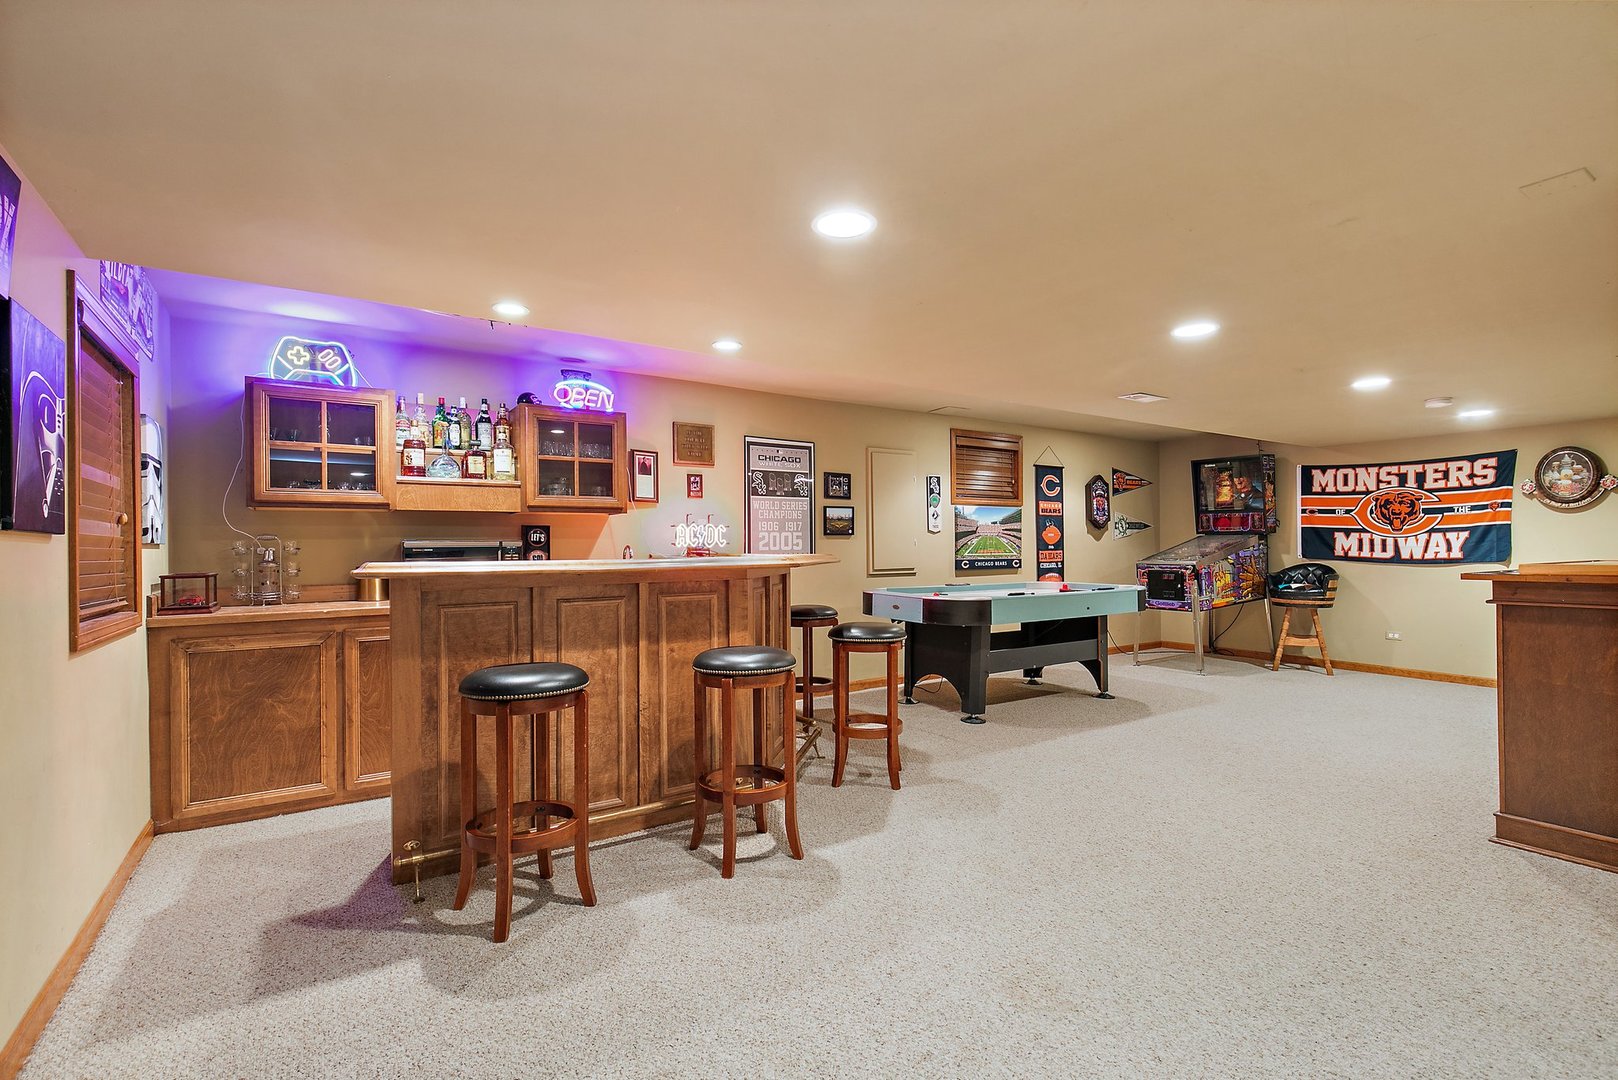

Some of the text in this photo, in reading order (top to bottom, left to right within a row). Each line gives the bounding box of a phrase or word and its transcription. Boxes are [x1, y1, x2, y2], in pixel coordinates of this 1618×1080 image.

[553, 385, 615, 410] OPEN
[758, 454, 802, 463] CHICAGO
[1311, 457, 1499, 493] MONSTERS
[753, 500, 808, 510] WORLD SERIES
[1453, 505, 1472, 514] THE
[758, 510, 803, 519] CHAMPIONS
[758, 521, 803, 531] 1906 1917
[530, 533, 545, 542] LET'S
[758, 532, 803, 551] 2005
[1333, 531, 1470, 560] MIDWAY
